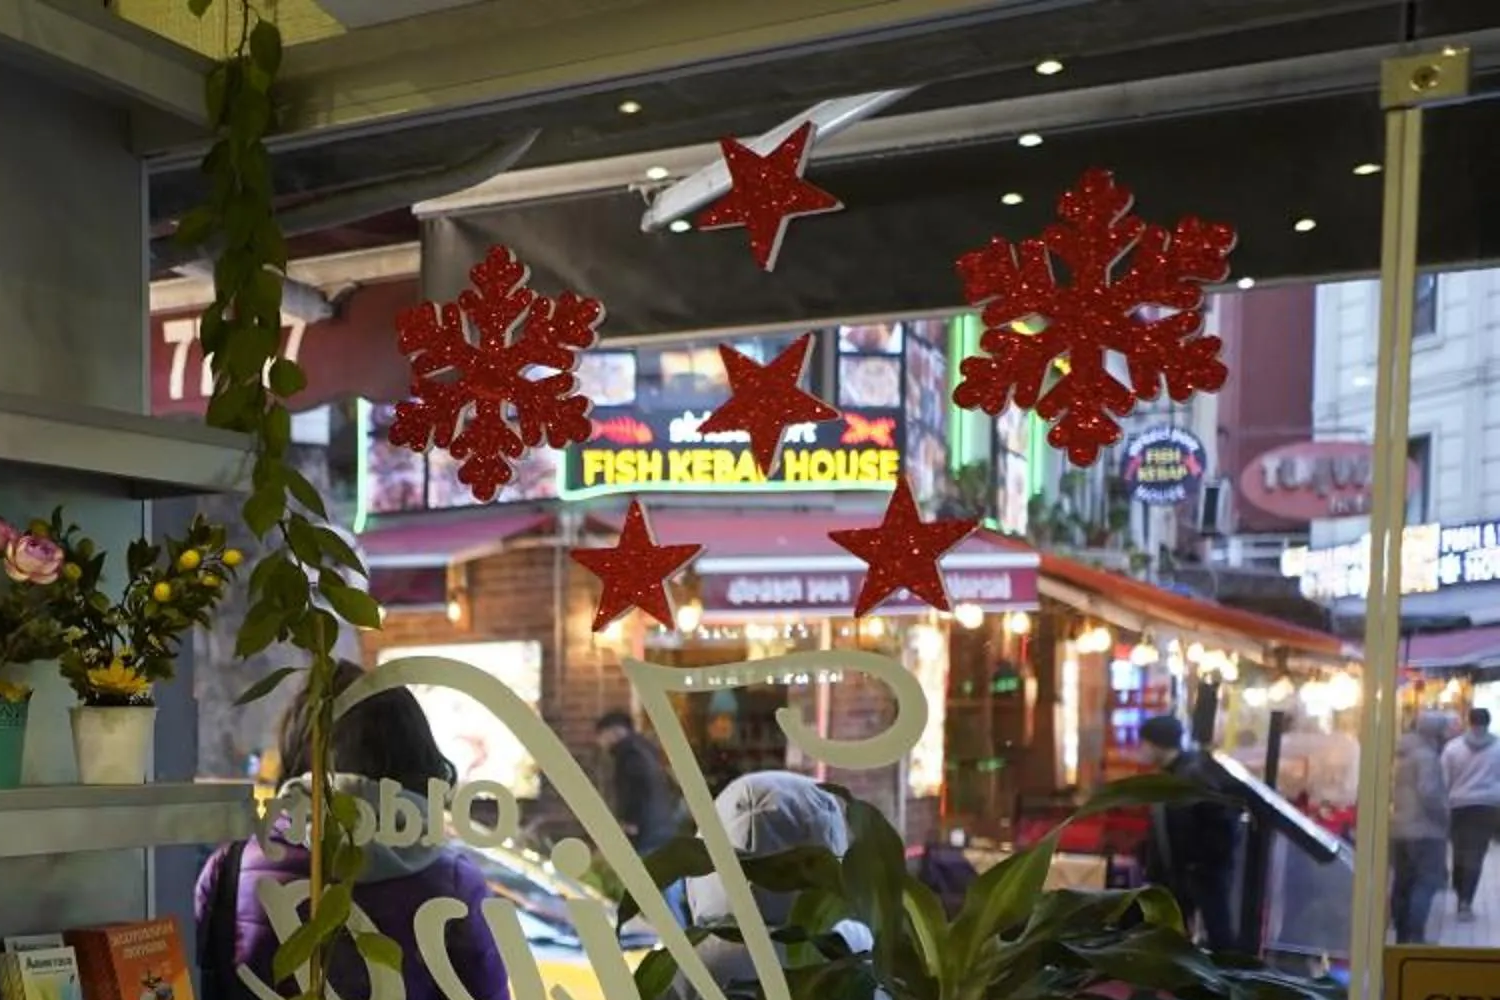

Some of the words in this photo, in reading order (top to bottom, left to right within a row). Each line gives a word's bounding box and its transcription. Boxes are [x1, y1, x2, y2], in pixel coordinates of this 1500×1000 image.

[582, 448, 662, 486] FISH
[668, 448, 768, 483] KEBA
[783, 448, 899, 483] HOUSE
